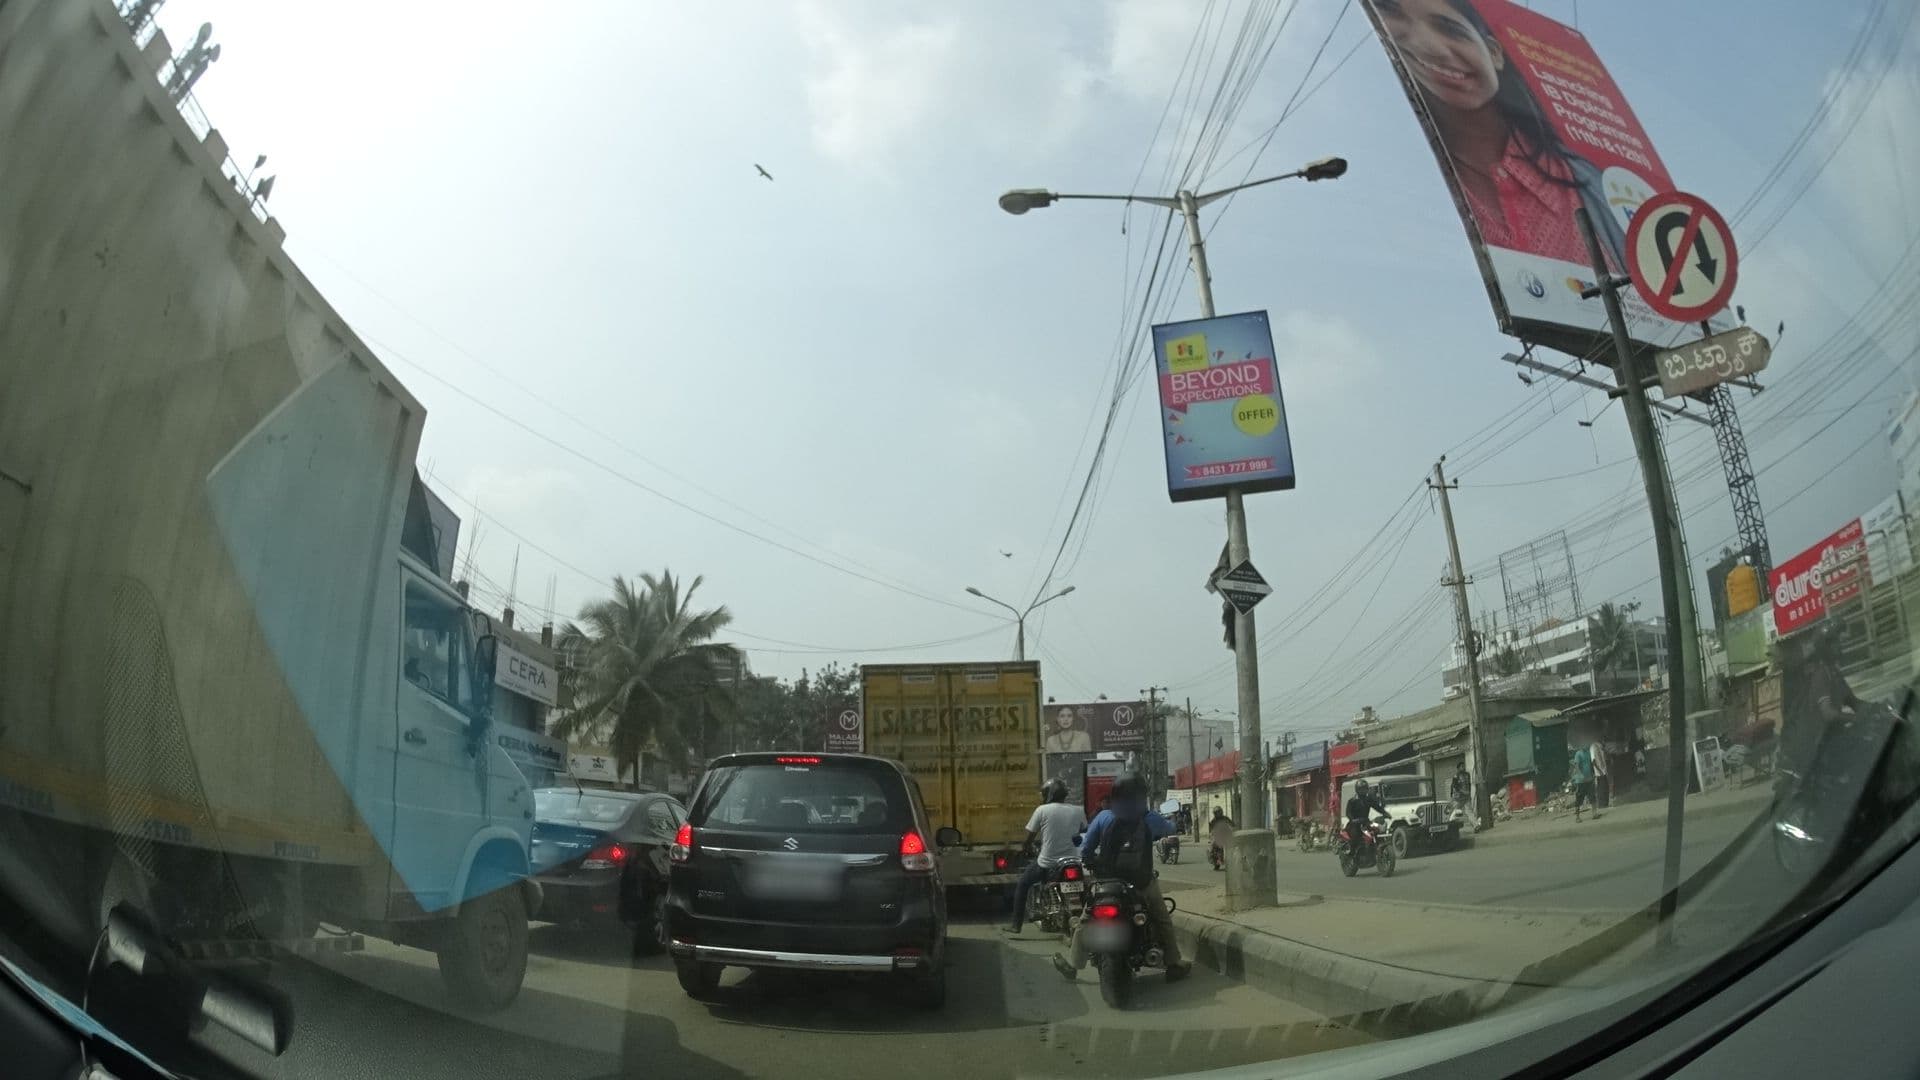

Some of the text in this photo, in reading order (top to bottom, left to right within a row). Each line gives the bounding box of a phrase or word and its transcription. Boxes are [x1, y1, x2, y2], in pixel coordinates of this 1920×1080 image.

[1540, 82, 1563, 100] IB
[1171, 364, 1260, 392] BEYOND
[1172, 383, 1262, 404] EXPECTATIONS
[1238, 408, 1275, 422] OFFER
[1203, 460, 1268, 477] 8431 777 999
[509, 656, 547, 689] CERA
[1103, 729, 1141, 737] MALABA
